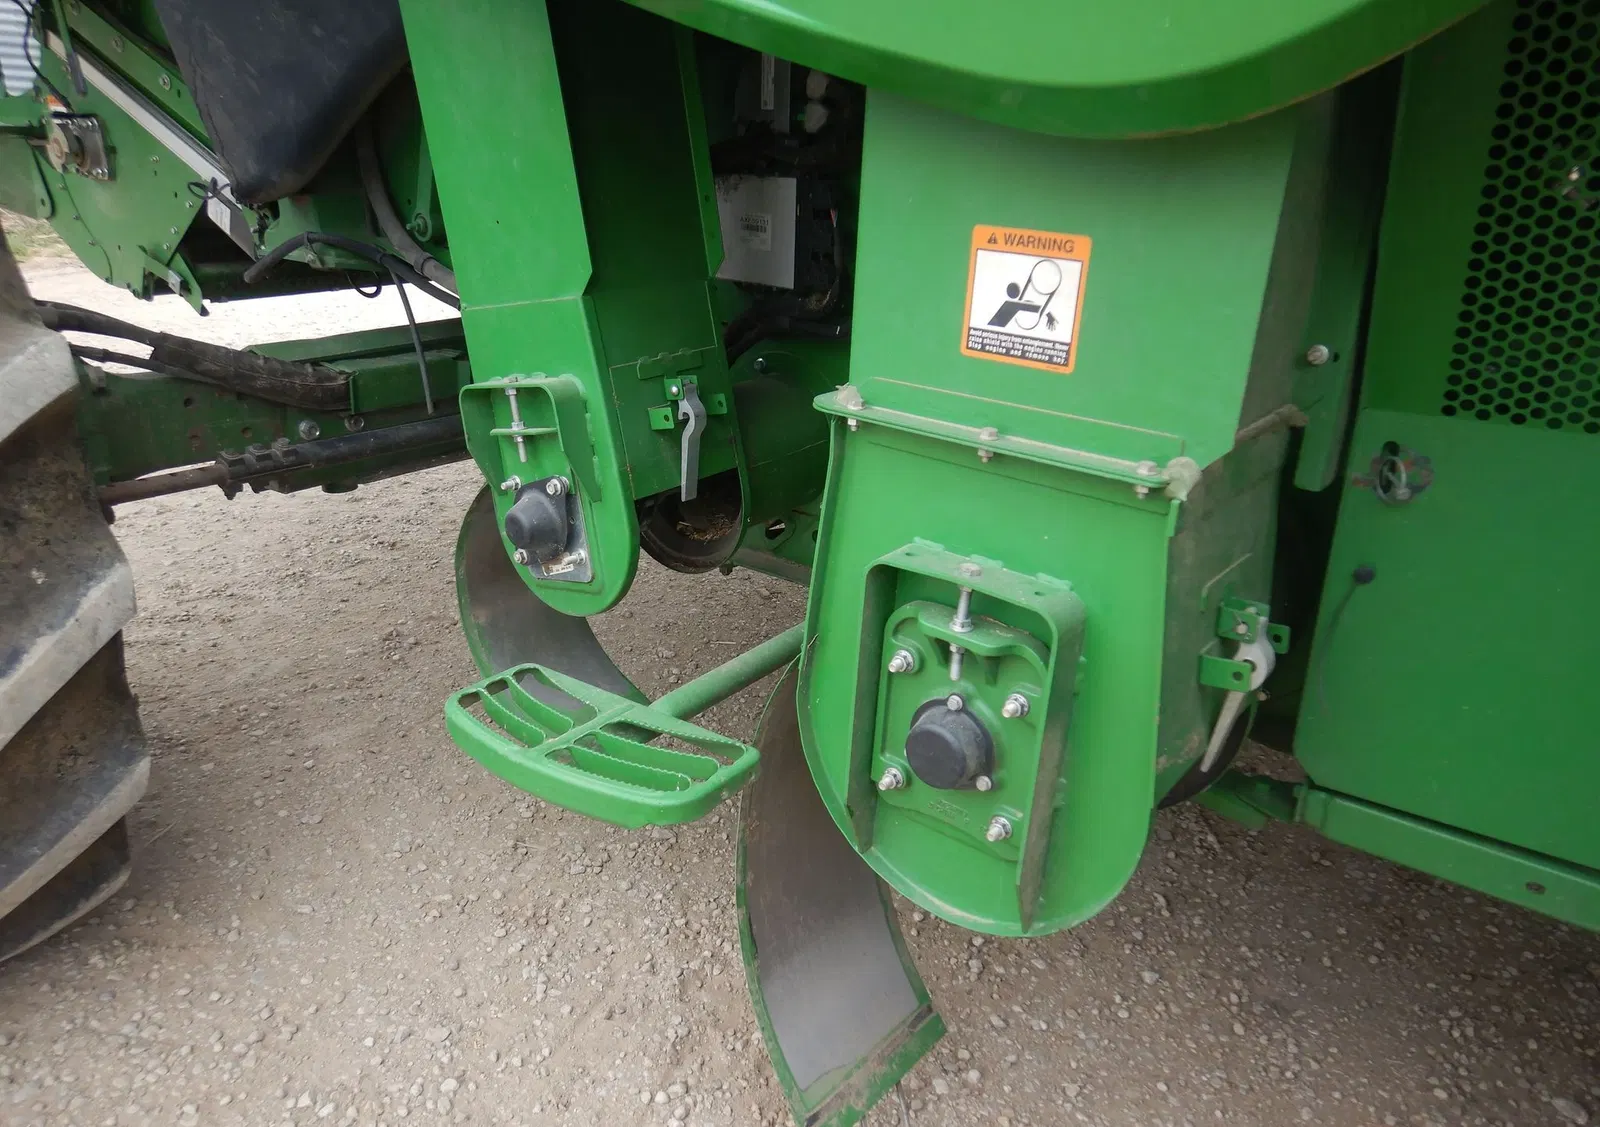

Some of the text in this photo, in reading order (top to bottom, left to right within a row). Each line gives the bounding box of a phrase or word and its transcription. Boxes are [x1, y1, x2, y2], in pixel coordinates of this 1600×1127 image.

[1003, 231, 1075, 253] WARNING
[969, 328, 982, 337] Avoid
[983, 338, 1000, 346] shield
[1001, 340, 1013, 348] with
[1013, 342, 1023, 350] the
[1023, 344, 1043, 353] engine
[985, 344, 1006, 353] engine
[1010, 349, 1021, 357] and
[1025, 351, 1049, 361] remove
